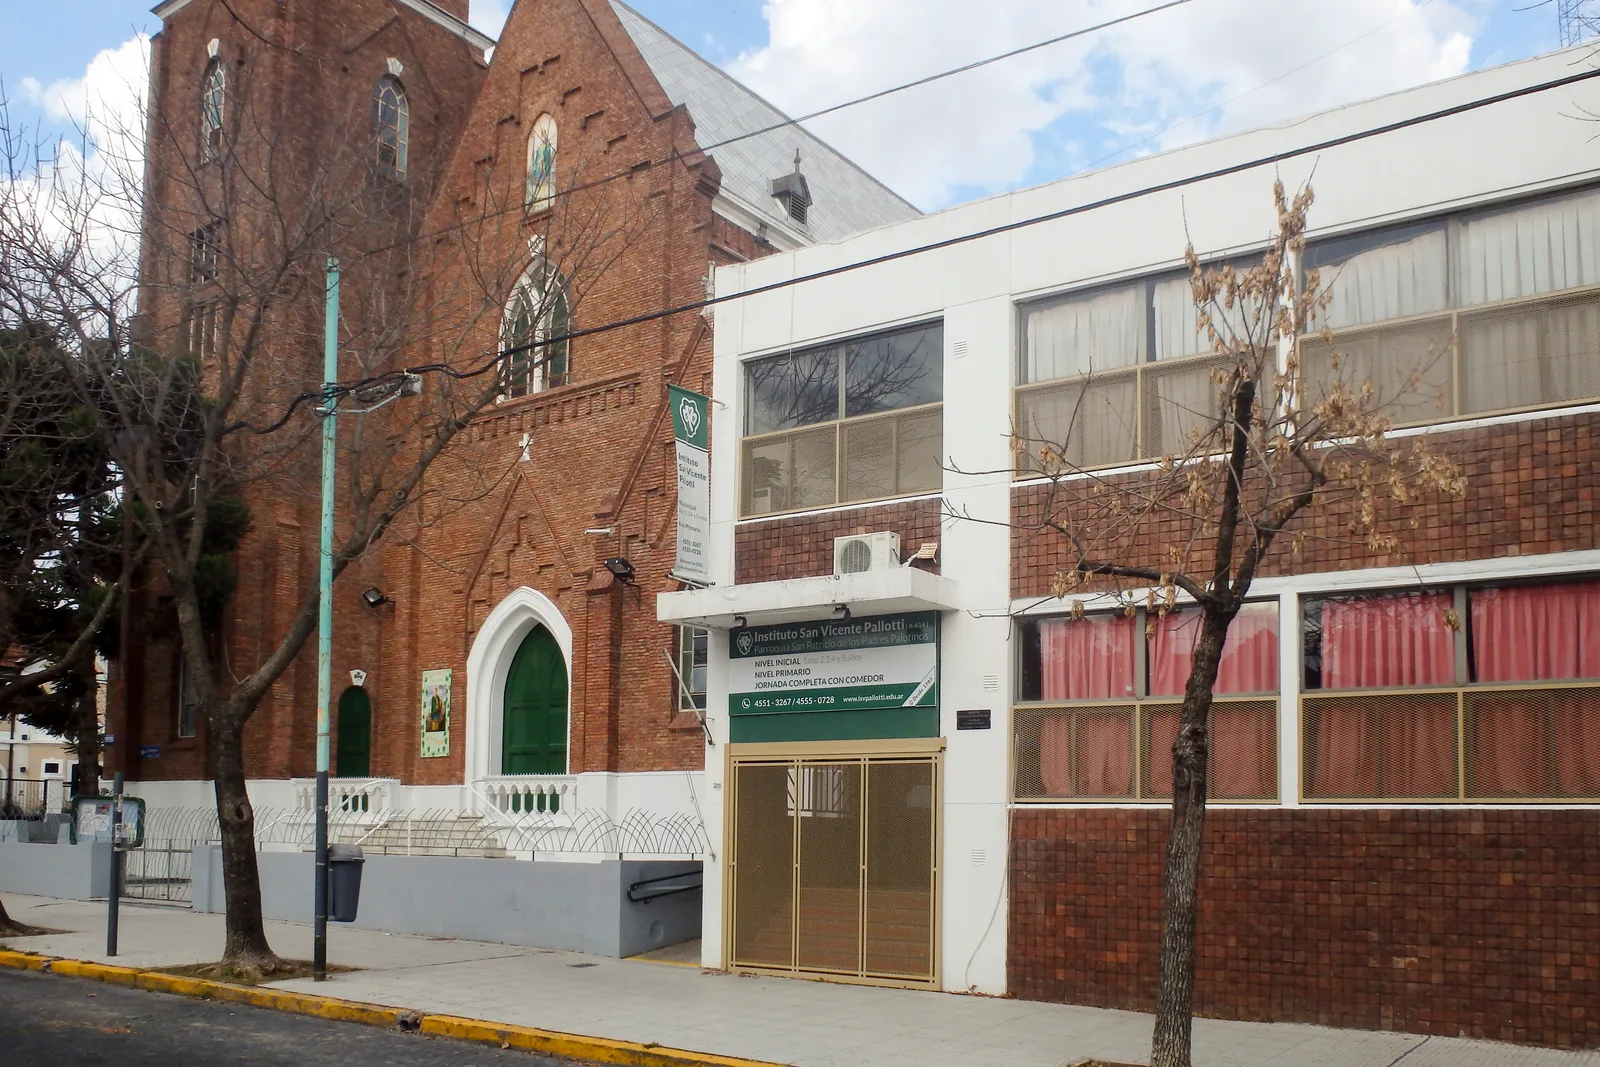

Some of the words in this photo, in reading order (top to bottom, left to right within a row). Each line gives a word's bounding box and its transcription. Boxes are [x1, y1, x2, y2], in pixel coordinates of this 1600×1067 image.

[754, 630, 797, 642] Instituto
[800, 627, 818, 638] San
[821, 624, 861, 636] Vicente
[864, 619, 904, 632] Pallotti
[755, 645, 789, 654] Parroquia
[791, 643, 804, 651] San
[807, 640, 835, 649] Patricio
[837, 639, 846, 647] de
[862, 635, 888, 645] Padres
[891, 633, 928, 643] Palotinos
[776, 658, 800, 666] INICIAL
[776, 668, 810, 677] PRIMARIO
[755, 681, 787, 689] JORNADA
[789, 678, 826, 687] COMPLETA
[846, 674, 884, 683] COMEDOR
